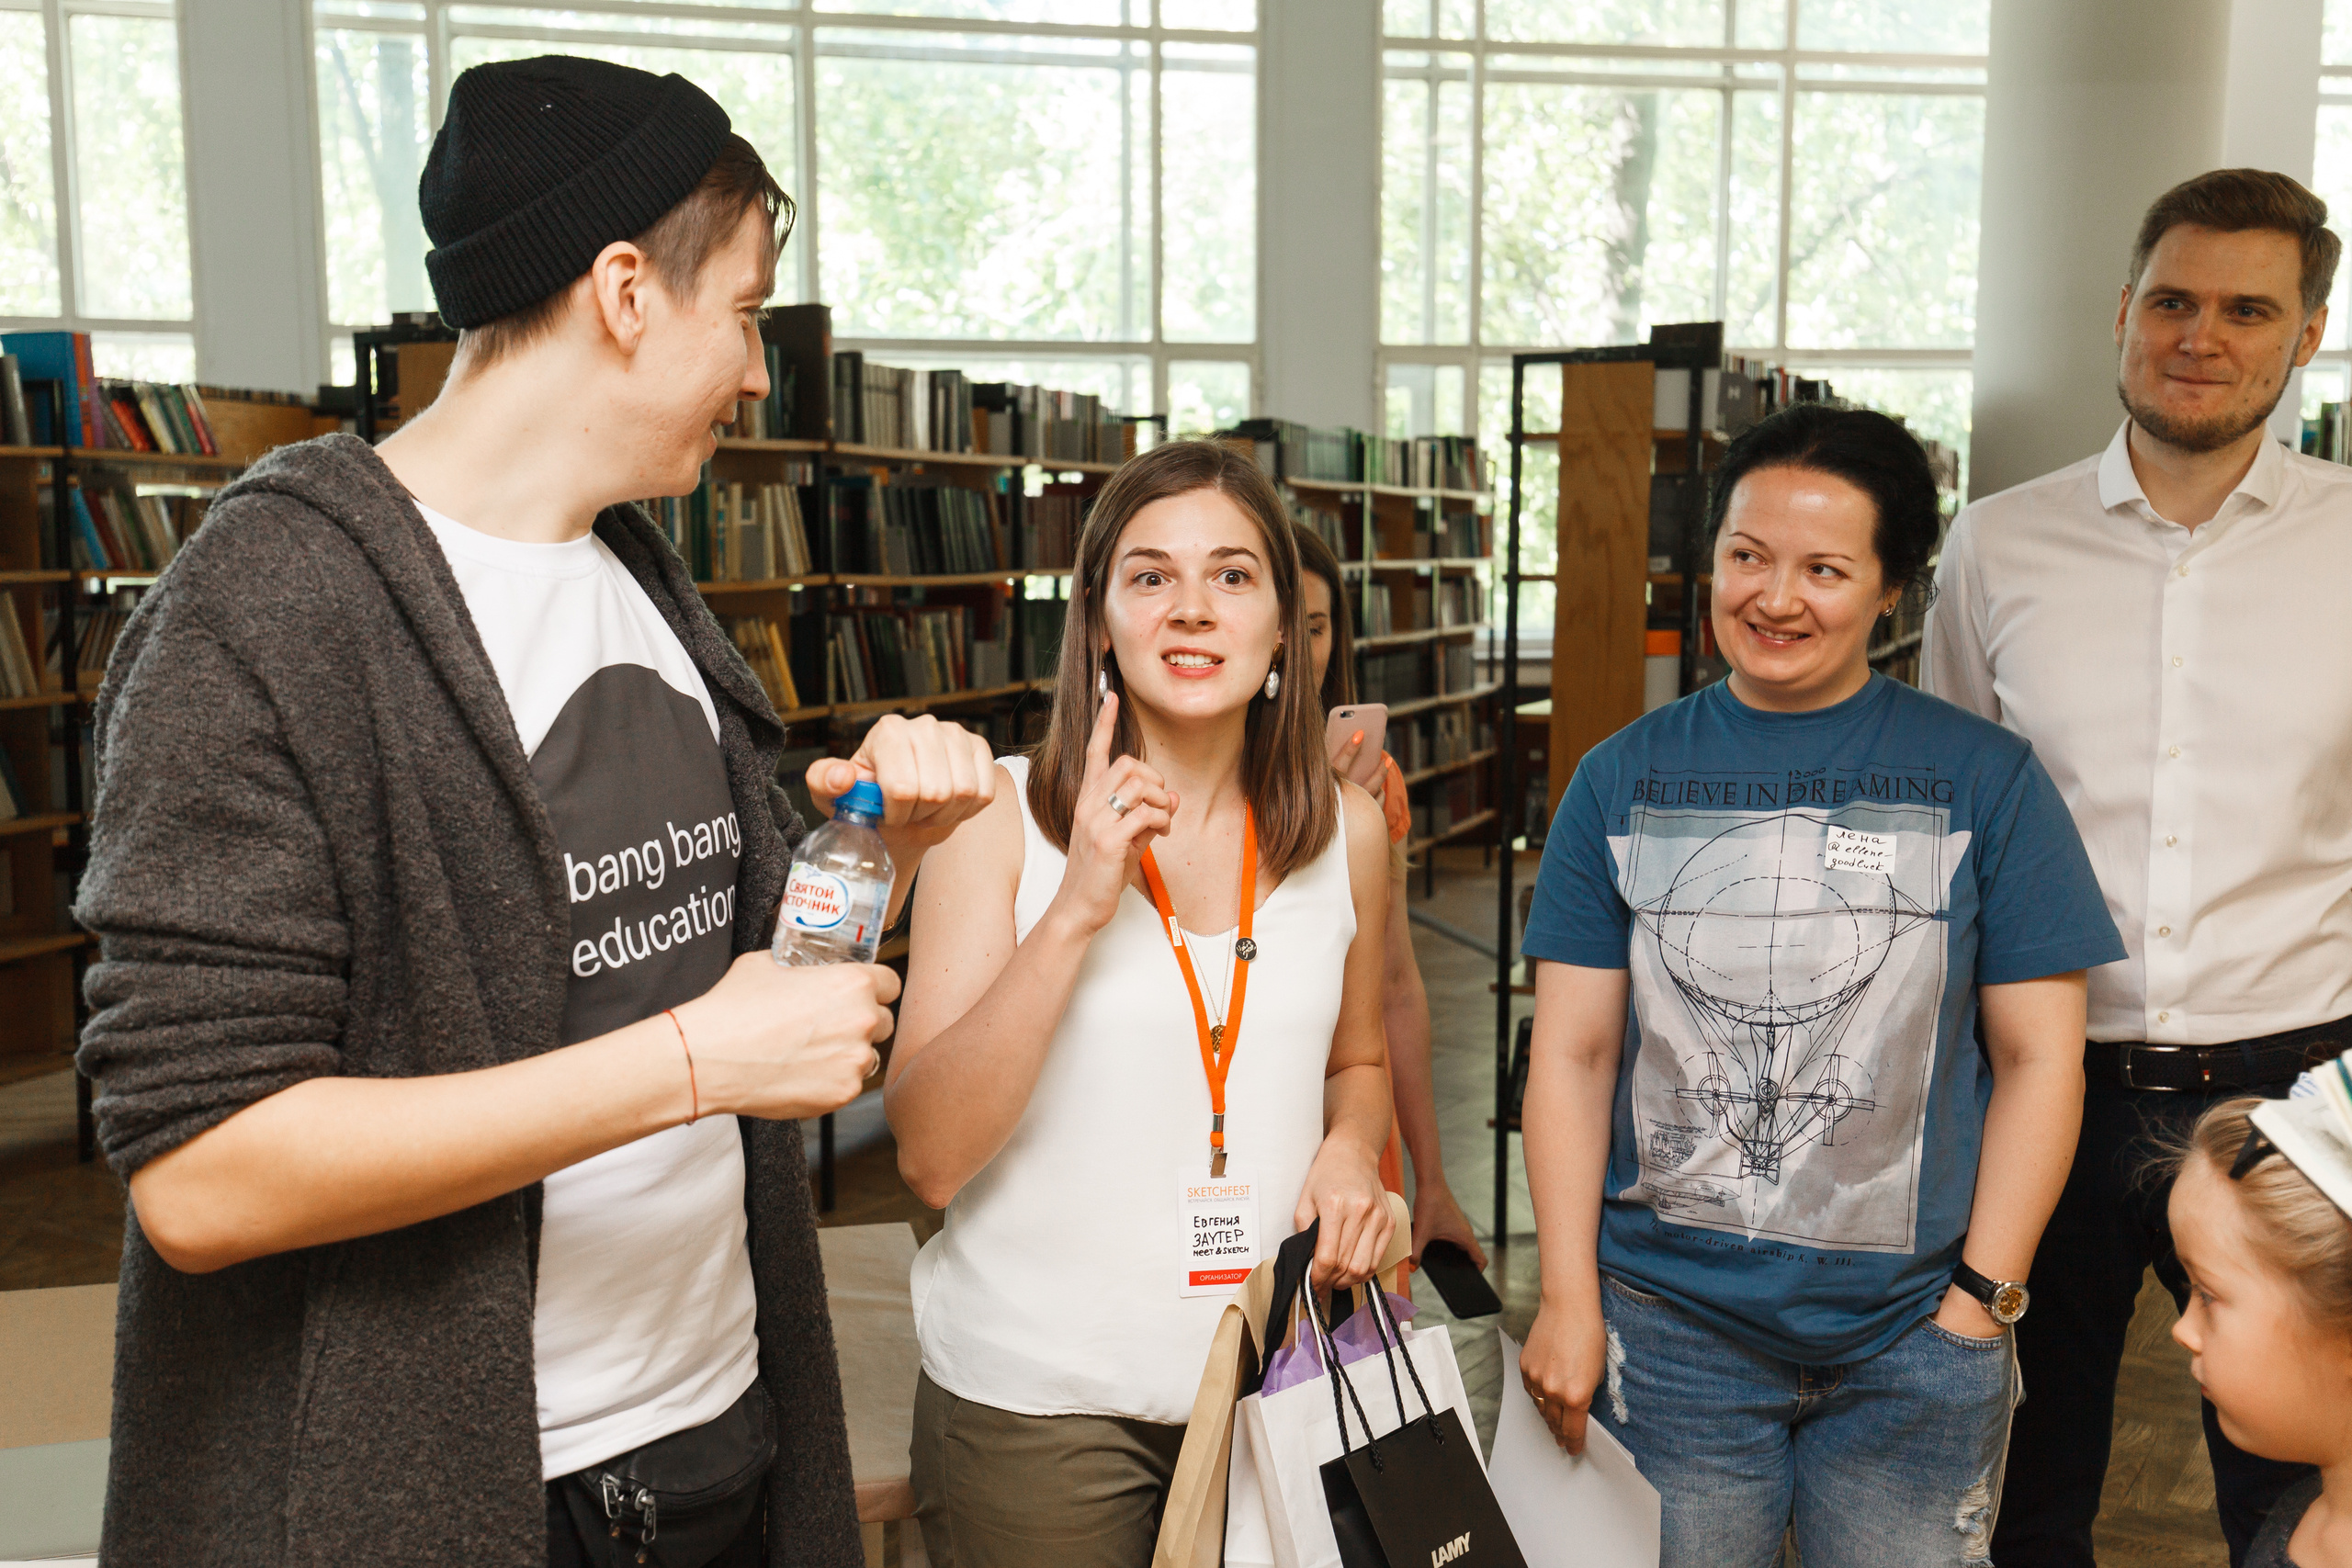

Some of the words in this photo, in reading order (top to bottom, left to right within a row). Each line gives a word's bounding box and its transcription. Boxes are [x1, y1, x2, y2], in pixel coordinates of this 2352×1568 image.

[1632, 778, 1737, 805] BELIEVE
[1746, 783, 1779, 806] IN
[1786, 772, 1954, 805] DREAMING
[563, 839, 665, 903] bang
[666, 811, 741, 868] bang
[571, 885, 736, 977] education
[1187, 1185, 1250, 1198] SKETCHFEST
[1193, 1229, 1244, 1247] ЗАУТЕР
[1664, 1229, 1745, 1252] motor-driven
[1749, 1246, 1794, 1262] airship
[1797, 1253, 1809, 1264] K.
[1199, 1273, 1243, 1281] ОРГАНИЗАТОР
[1430, 1531, 1471, 1568] LAMY
